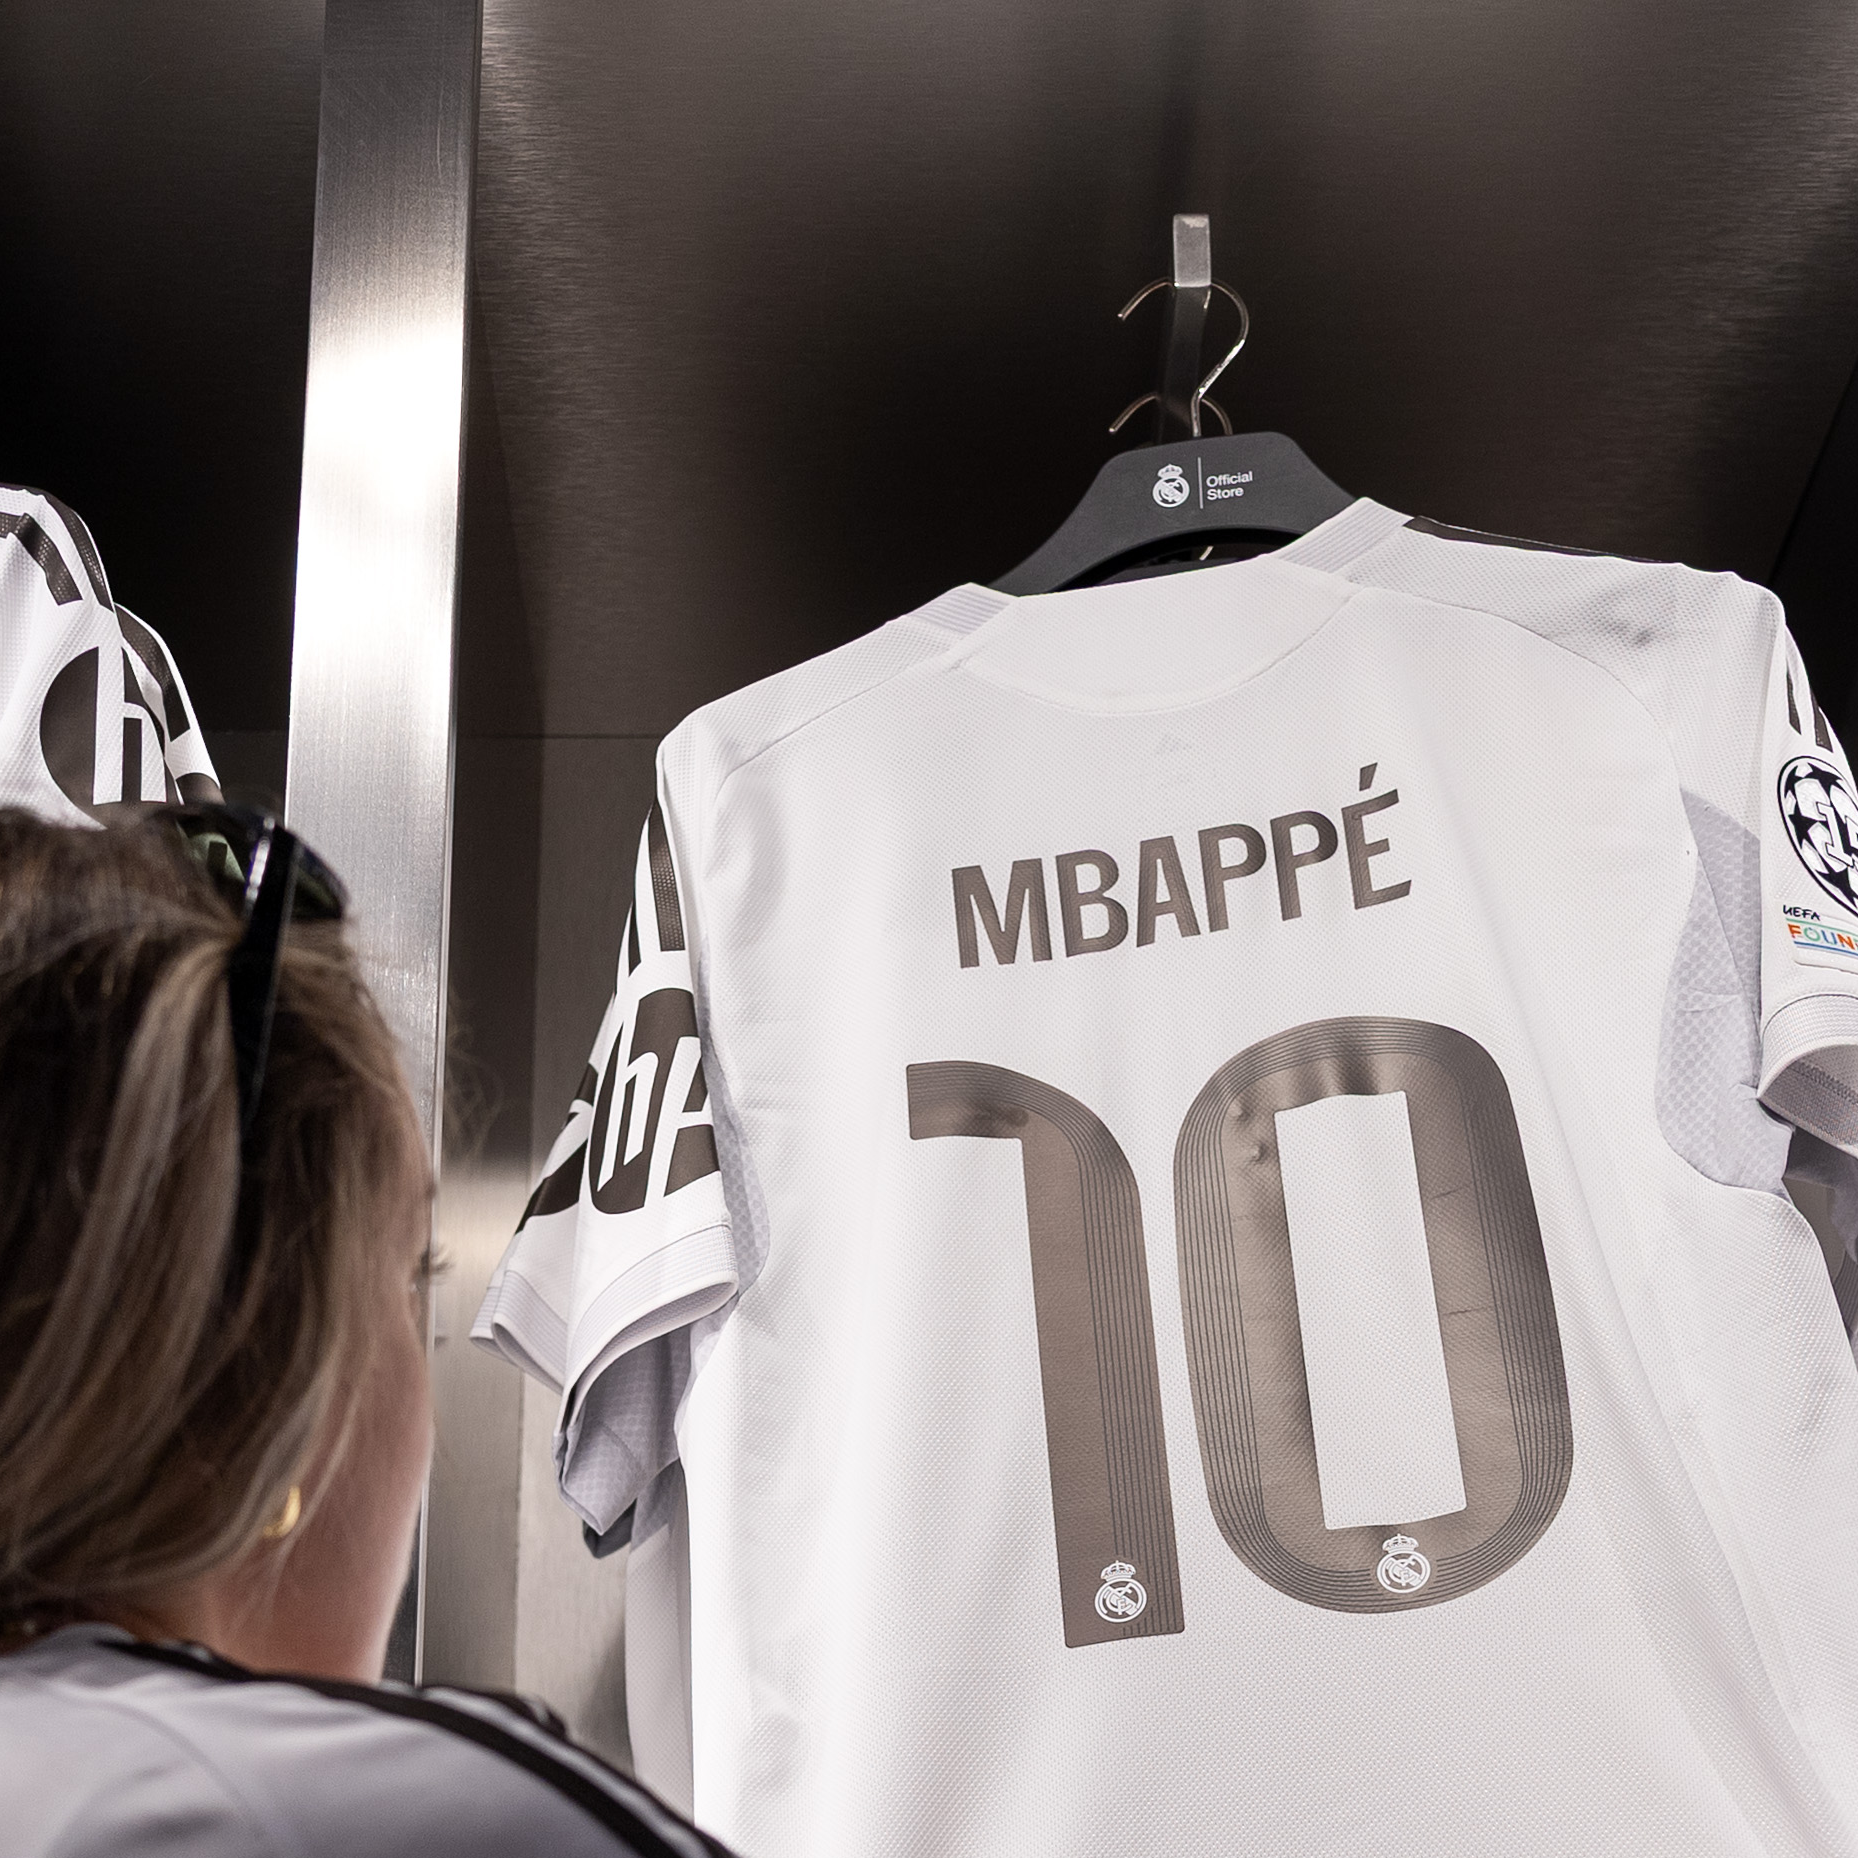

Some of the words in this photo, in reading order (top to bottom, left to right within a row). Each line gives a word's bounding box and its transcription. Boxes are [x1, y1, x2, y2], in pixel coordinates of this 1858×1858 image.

[1205, 470, 1254, 488] Official
[1206, 487, 1245, 501] Store
[951, 762, 1413, 969] MBAPPÉ
[1782, 904, 1821, 921] UEFA
[905, 1015, 1575, 1649] 10
